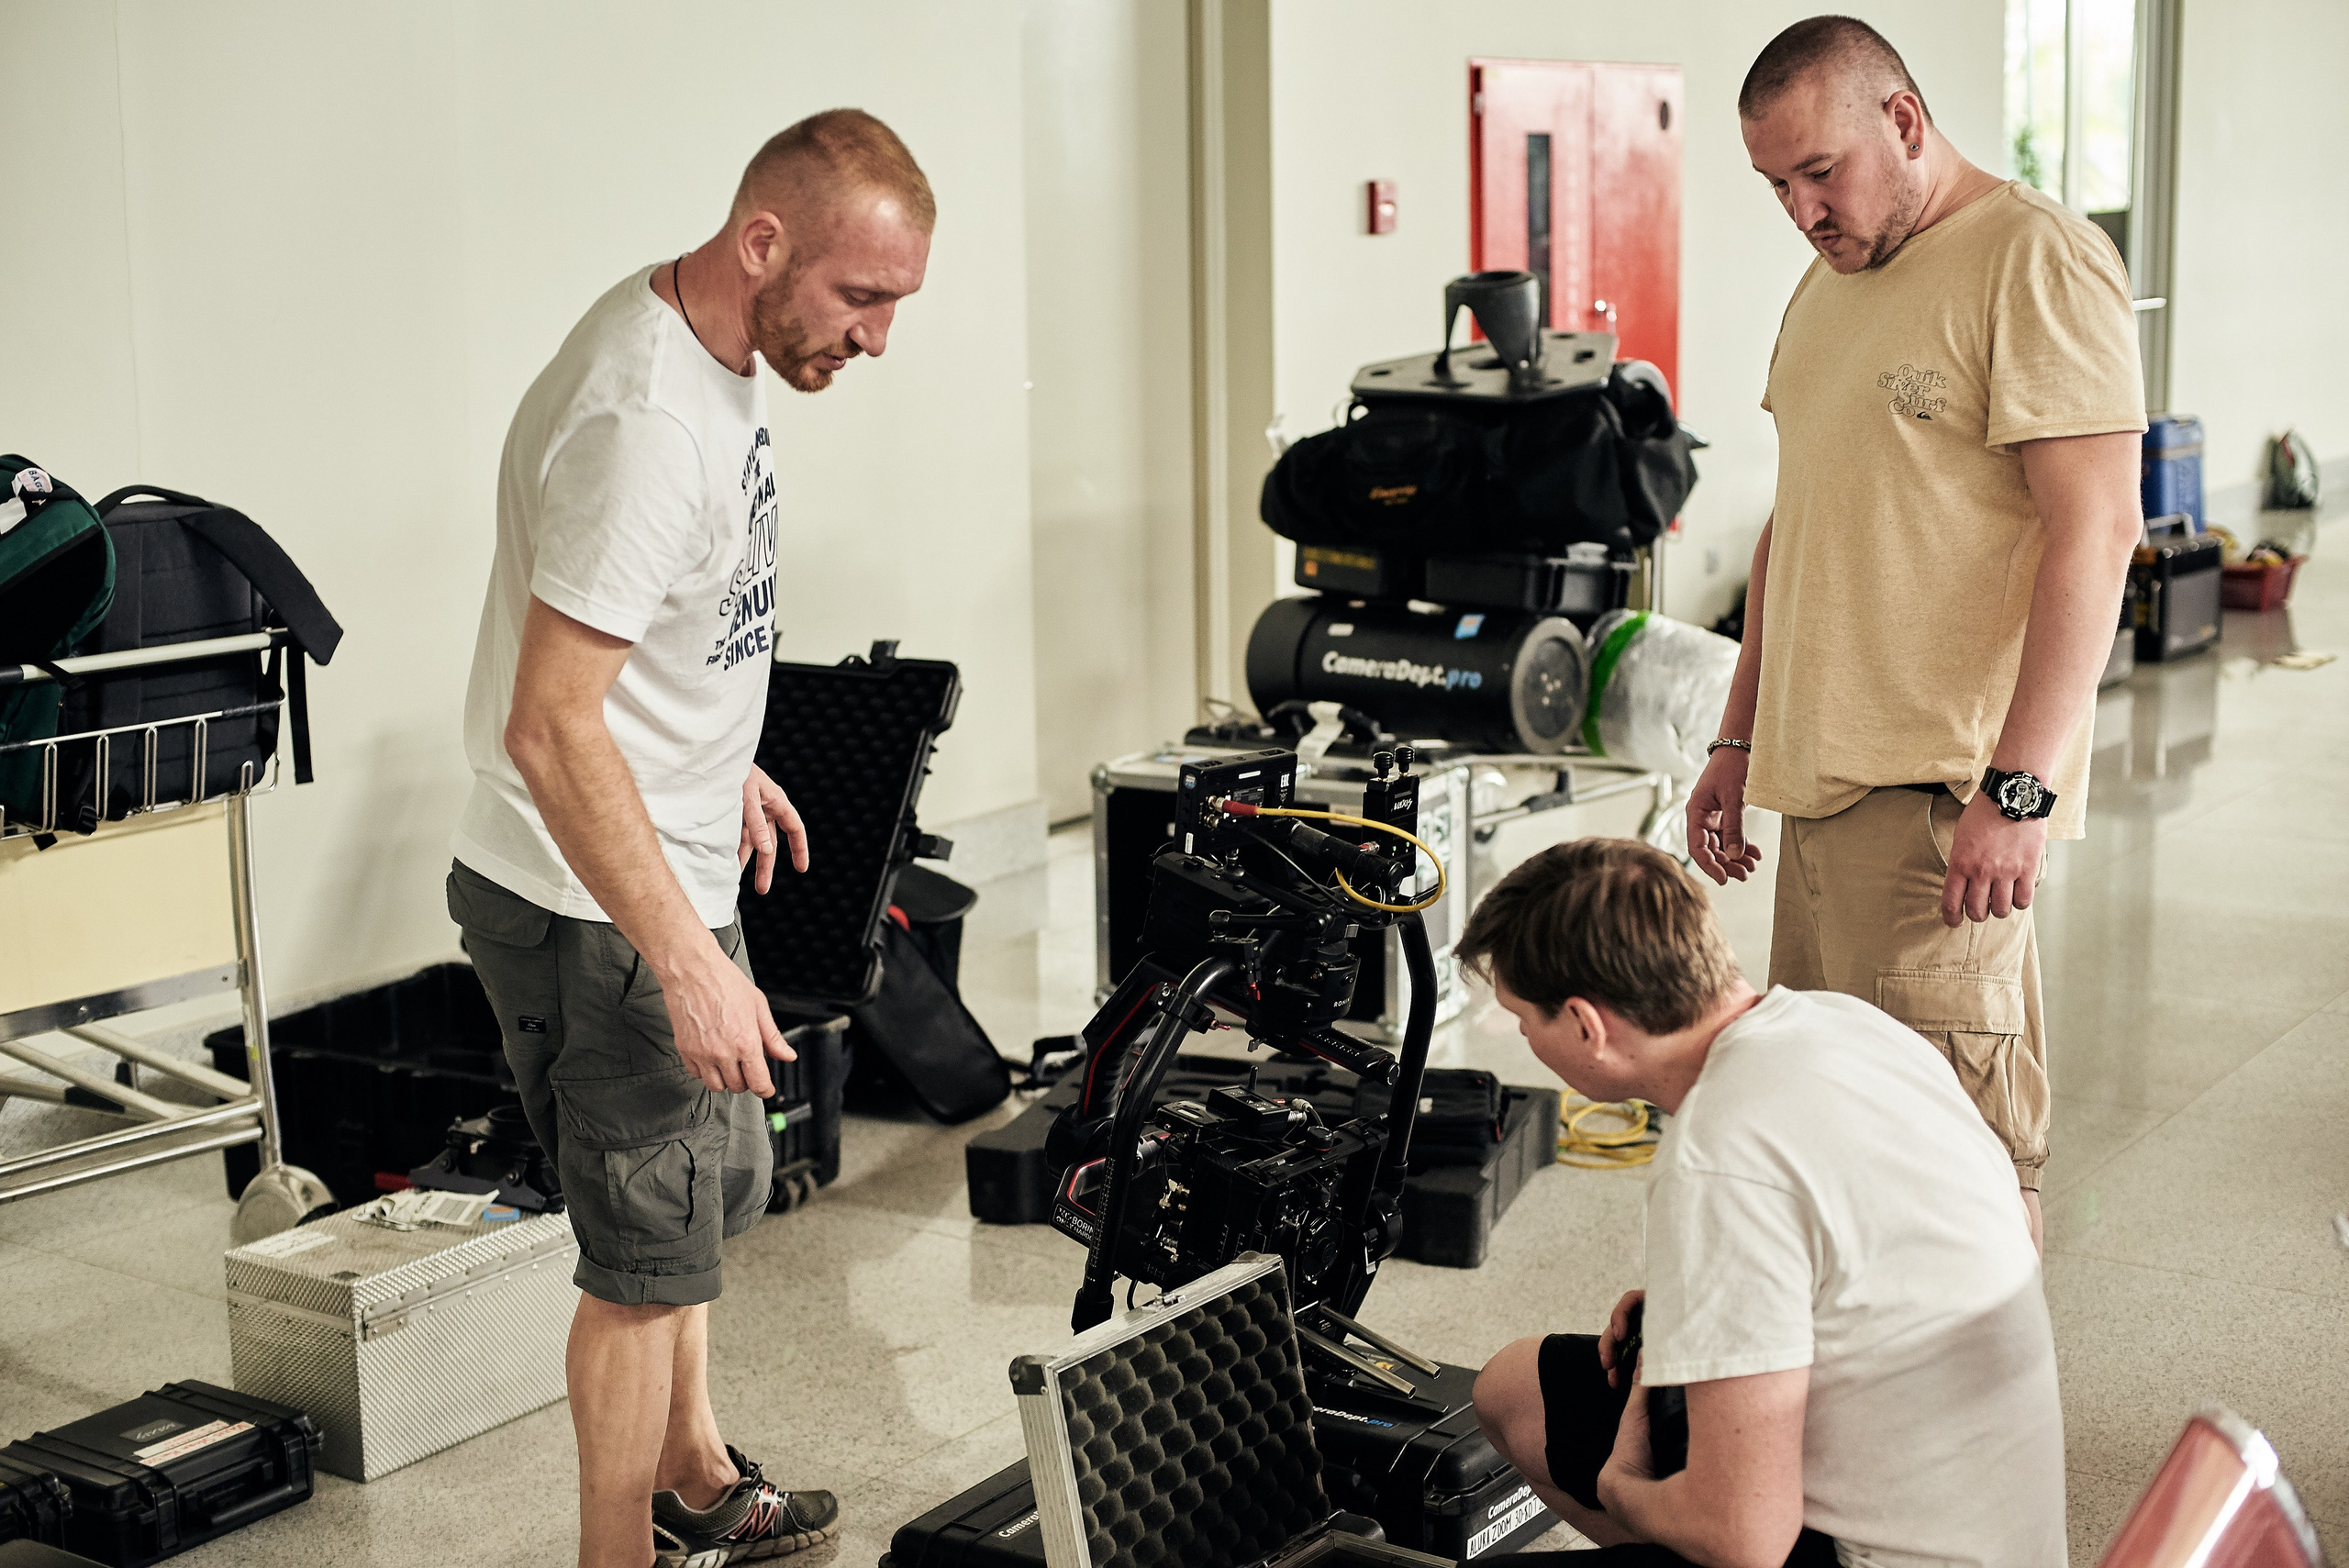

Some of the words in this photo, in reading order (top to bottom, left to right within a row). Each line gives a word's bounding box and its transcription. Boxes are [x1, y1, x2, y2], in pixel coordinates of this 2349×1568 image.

[1898, 364, 1946, 388] Quik
[1898, 386, 1947, 413] Surf
[724, 626, 770, 671] SINCE
[1072, 1216, 1094, 1234] BORIN
[1312, 1406, 1394, 1428] eraDept.pro
[1488, 1485, 1532, 1519] CameraDep
[998, 1510, 1040, 1538] Camera
[1491, 1514, 1512, 1542] ZOOM
